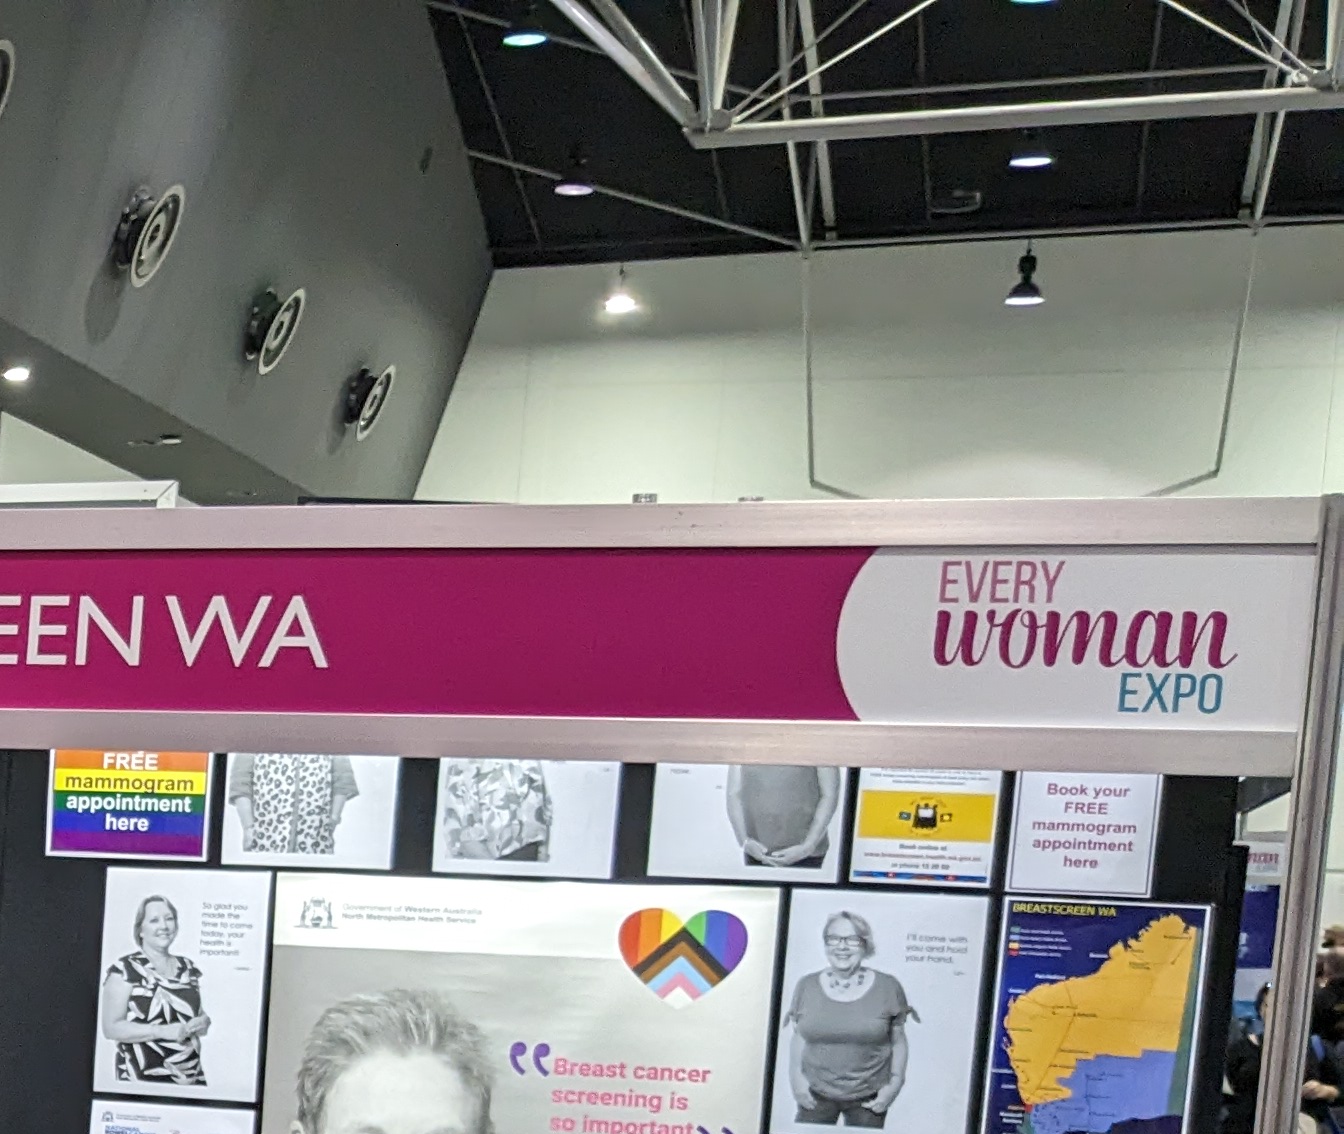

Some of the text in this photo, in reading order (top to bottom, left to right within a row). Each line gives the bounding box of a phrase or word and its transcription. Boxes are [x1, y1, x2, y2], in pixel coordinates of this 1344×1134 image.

[938, 560, 1066, 604] EVERY
[166, 594, 330, 669] WA
[933, 607, 1239, 669] woman
[1117, 672, 1224, 714] EXPO
[103, 751, 159, 771] FREE
[64, 775, 194, 794] mammogram
[1046, 783, 1131, 800] Book your
[66, 794, 192, 814] appointment
[1064, 801, 1109, 815] FREE
[105, 813, 150, 832] here
[1032, 820, 1138, 836] mammogram
[1032, 837, 1135, 853] appointment
[1063, 855, 1099, 869] here
[552, 1057, 712, 1083] Breast cancer
[551, 1088, 689, 1114] screening is
[549, 1116, 576, 1132] so
